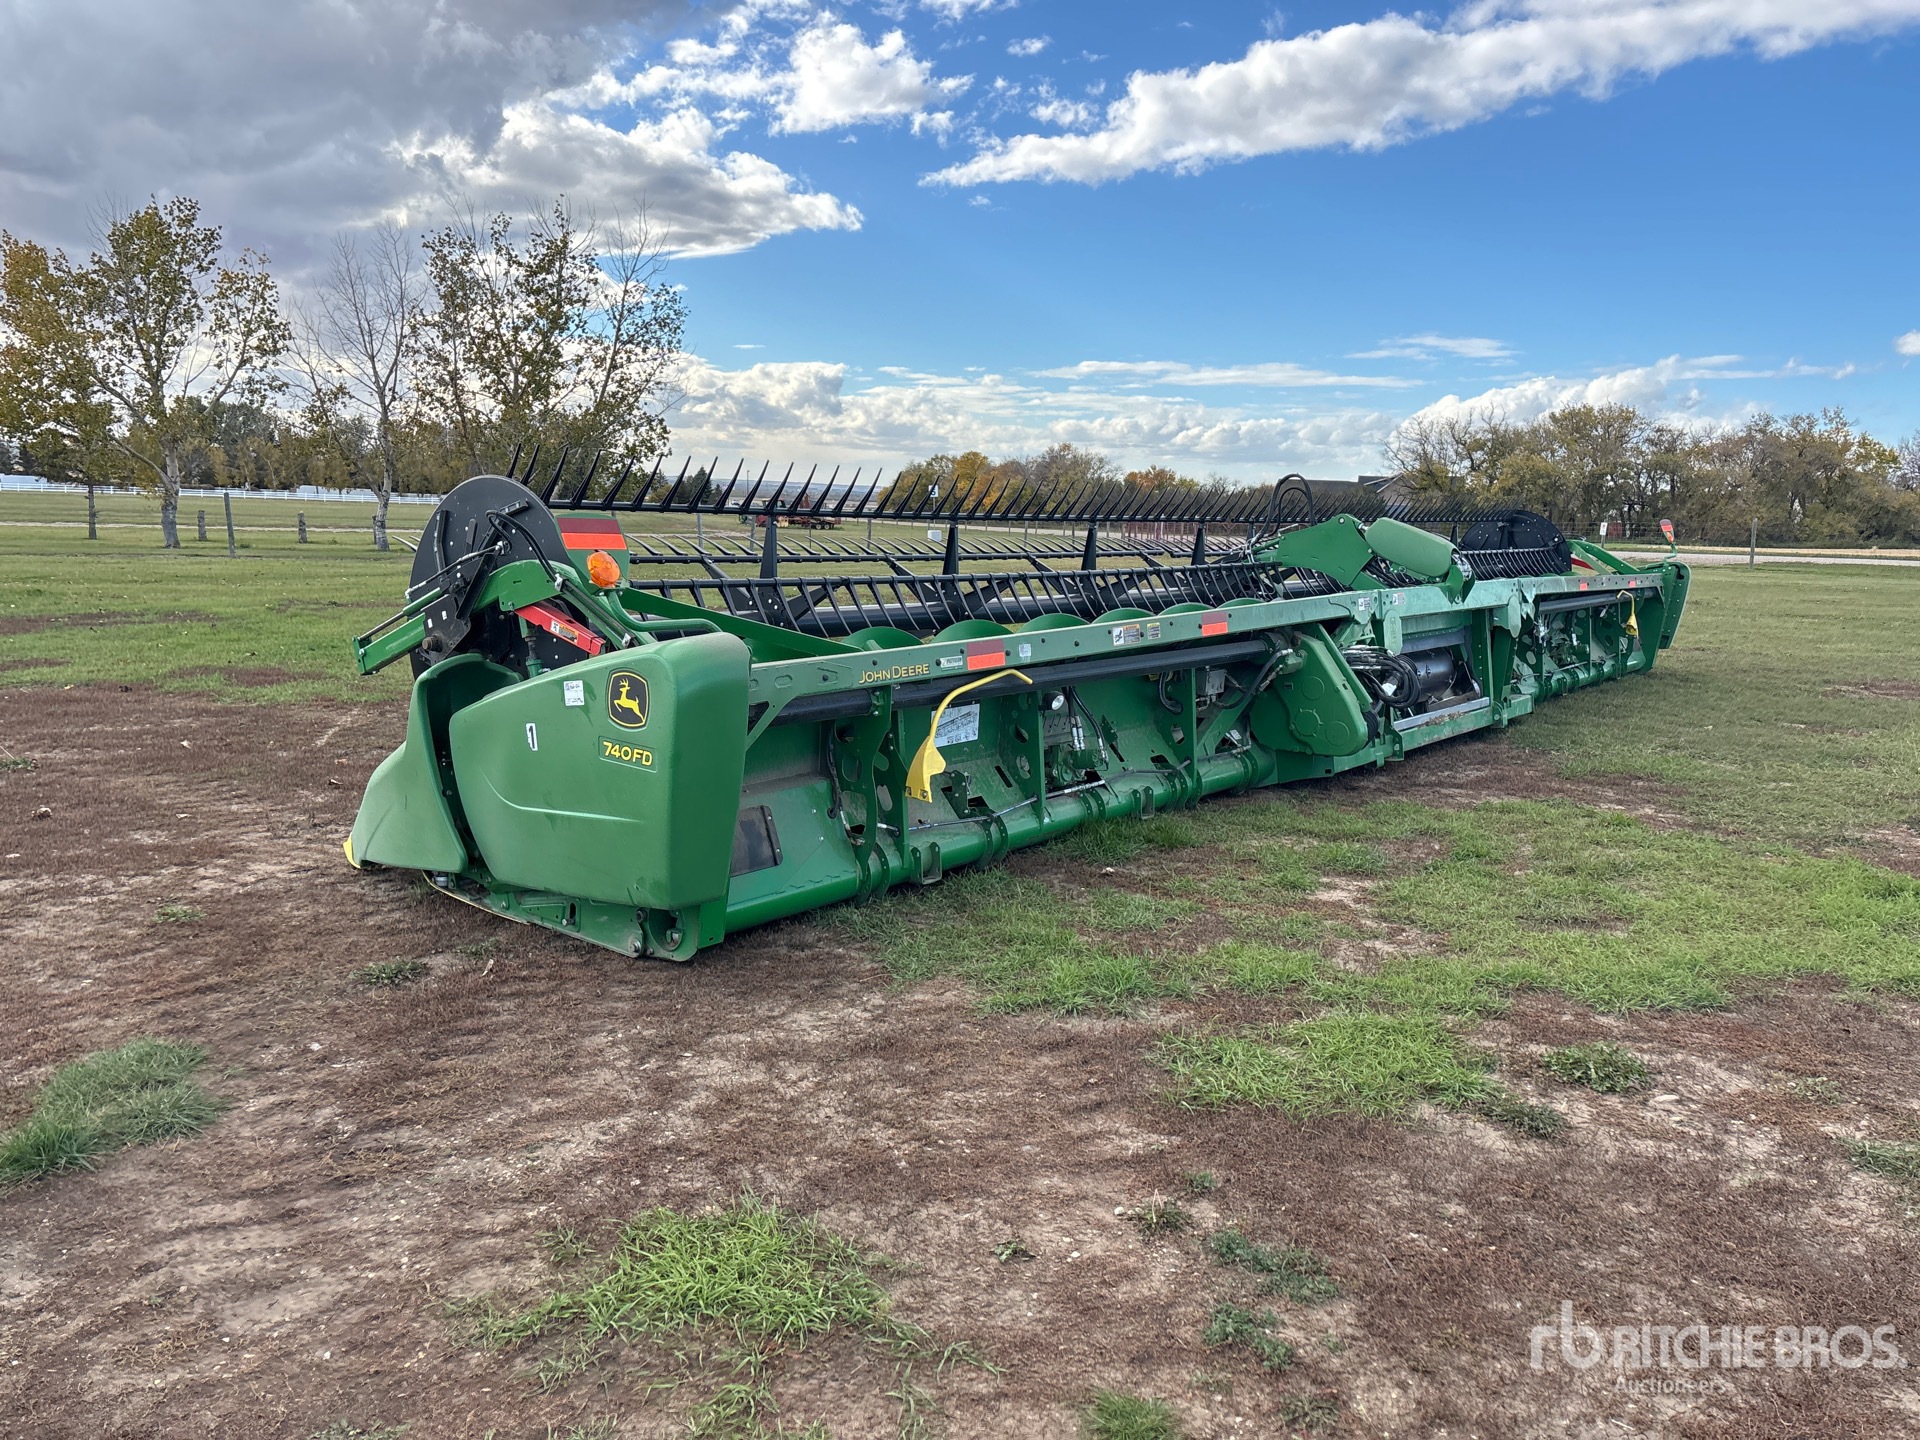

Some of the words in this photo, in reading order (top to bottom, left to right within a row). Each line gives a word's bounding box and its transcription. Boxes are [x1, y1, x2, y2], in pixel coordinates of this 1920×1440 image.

[859, 670, 891, 684] JOHN
[892, 664, 930, 679] DEERE
[528, 725, 536, 749] 1
[602, 741, 653, 766] 740FD
